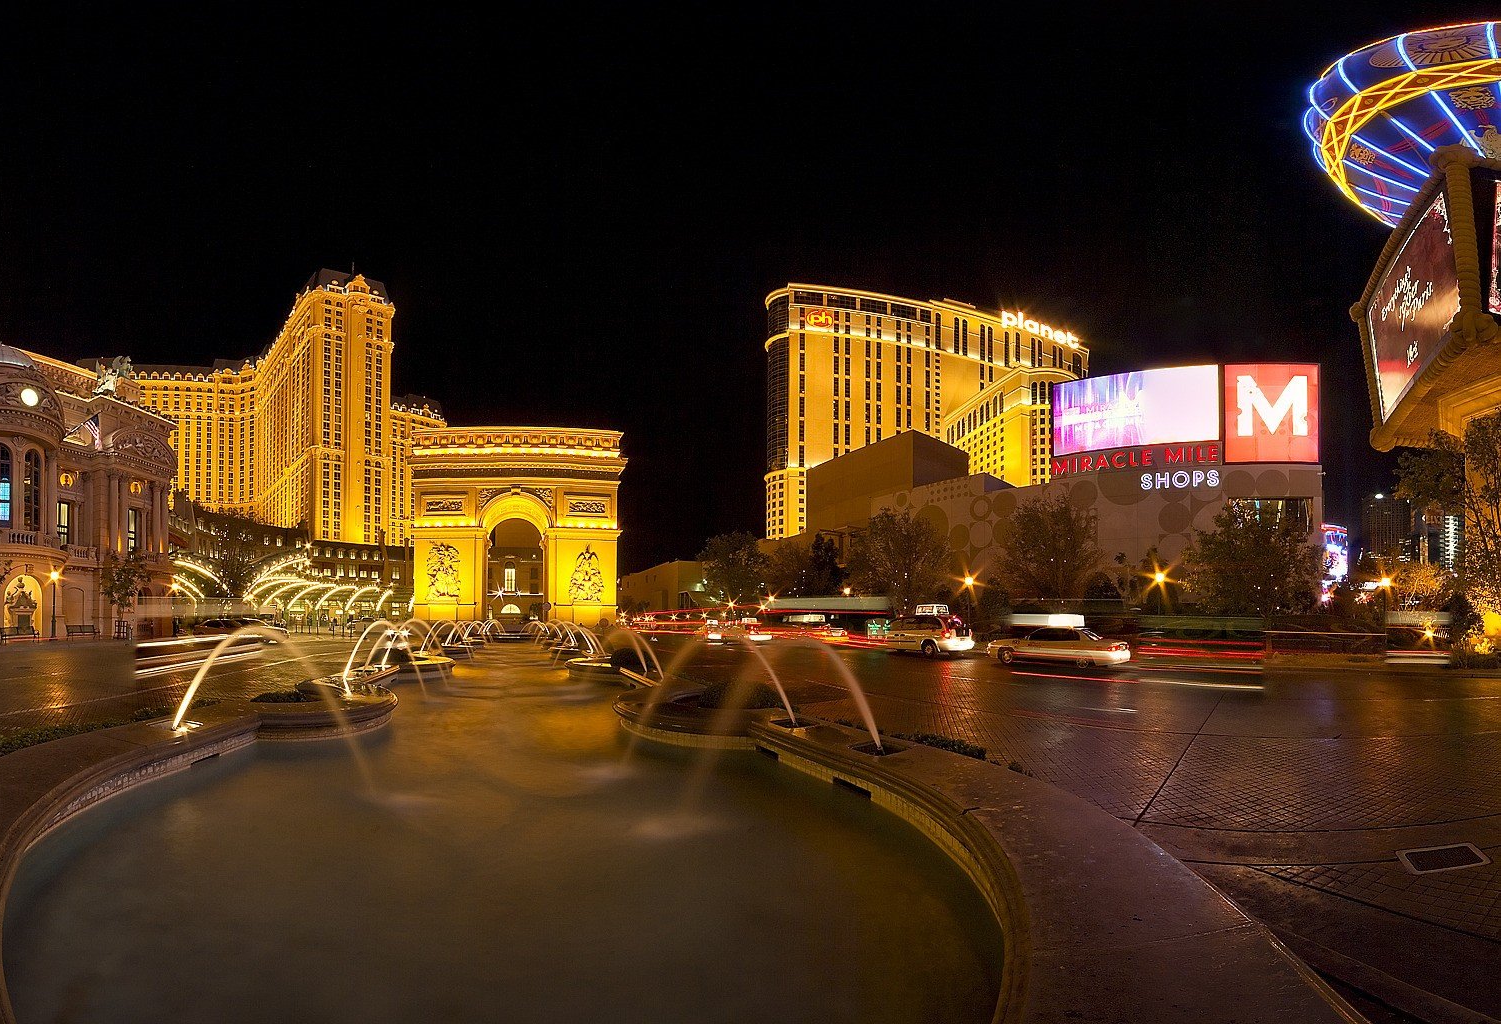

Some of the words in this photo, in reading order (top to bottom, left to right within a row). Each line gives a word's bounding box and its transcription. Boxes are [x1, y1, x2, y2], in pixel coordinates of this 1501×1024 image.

[810, 311, 833, 325] ph
[1001, 310, 1079, 349] planet
[1237, 376, 1308, 436] M
[1052, 450, 1152, 475] MIRACLE
[1165, 445, 1219, 464] MILE
[1141, 470, 1220, 490] SHOPS
